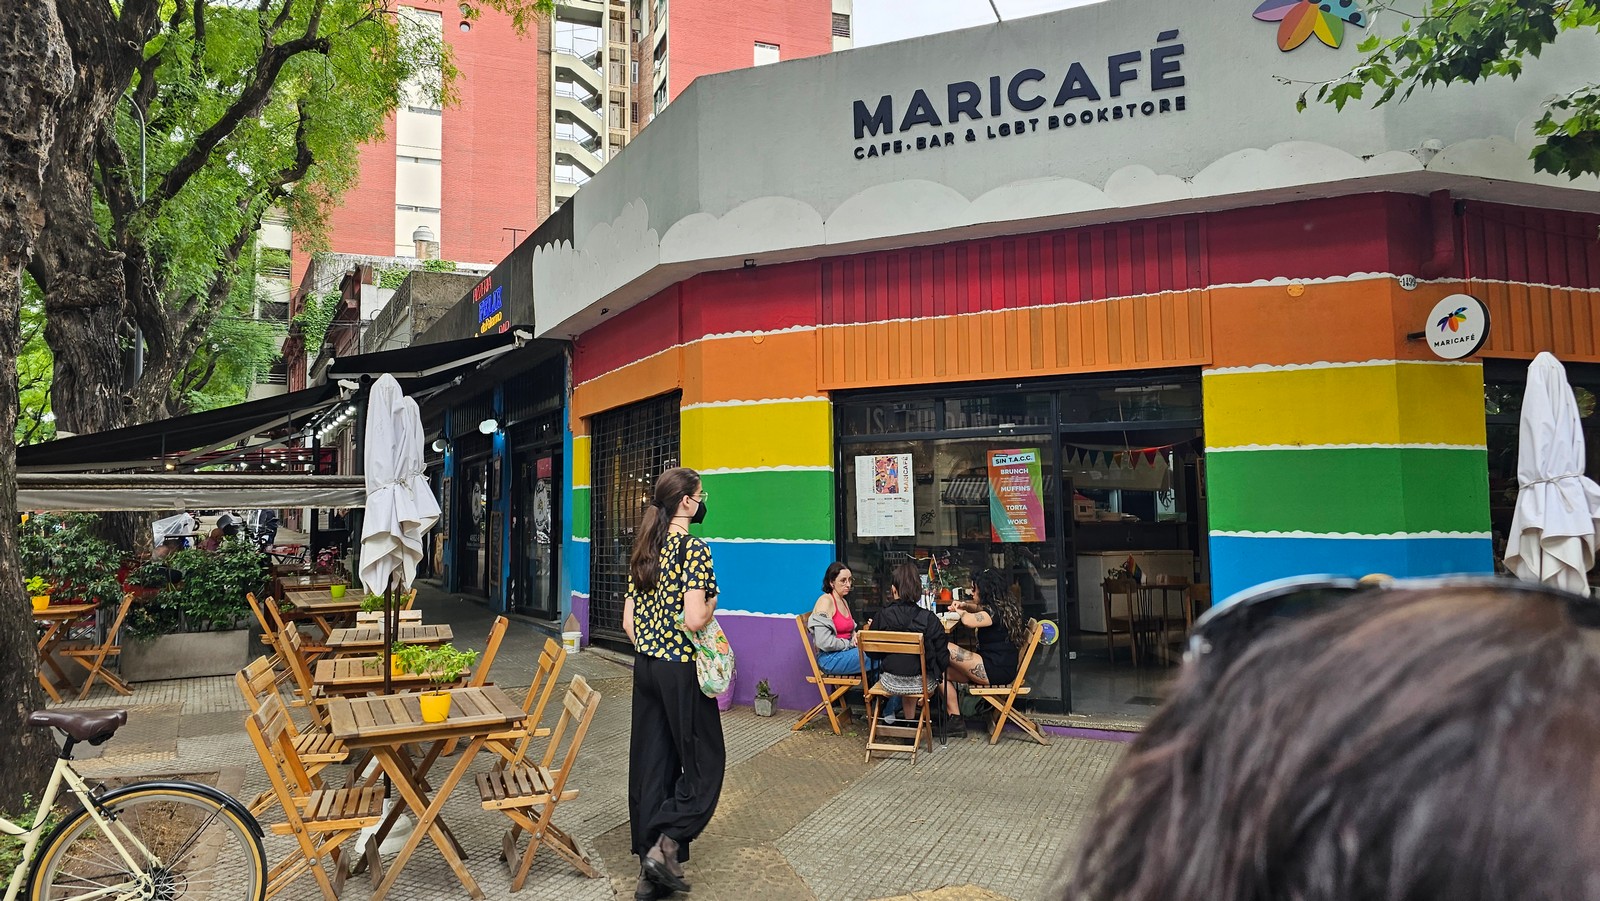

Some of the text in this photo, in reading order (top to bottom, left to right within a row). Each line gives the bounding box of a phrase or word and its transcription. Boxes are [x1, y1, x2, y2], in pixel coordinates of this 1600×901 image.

[853, 29, 1185, 140] MARICAFÉ
[965, 128, 976, 142] &
[987, 118, 1039, 139] LGBT
[1048, 95, 1186, 130] BOOKSTORE
[1434, 333, 1475, 348] MARICAFÉ
[1008, 455, 1033, 463] T.A.C.C.
